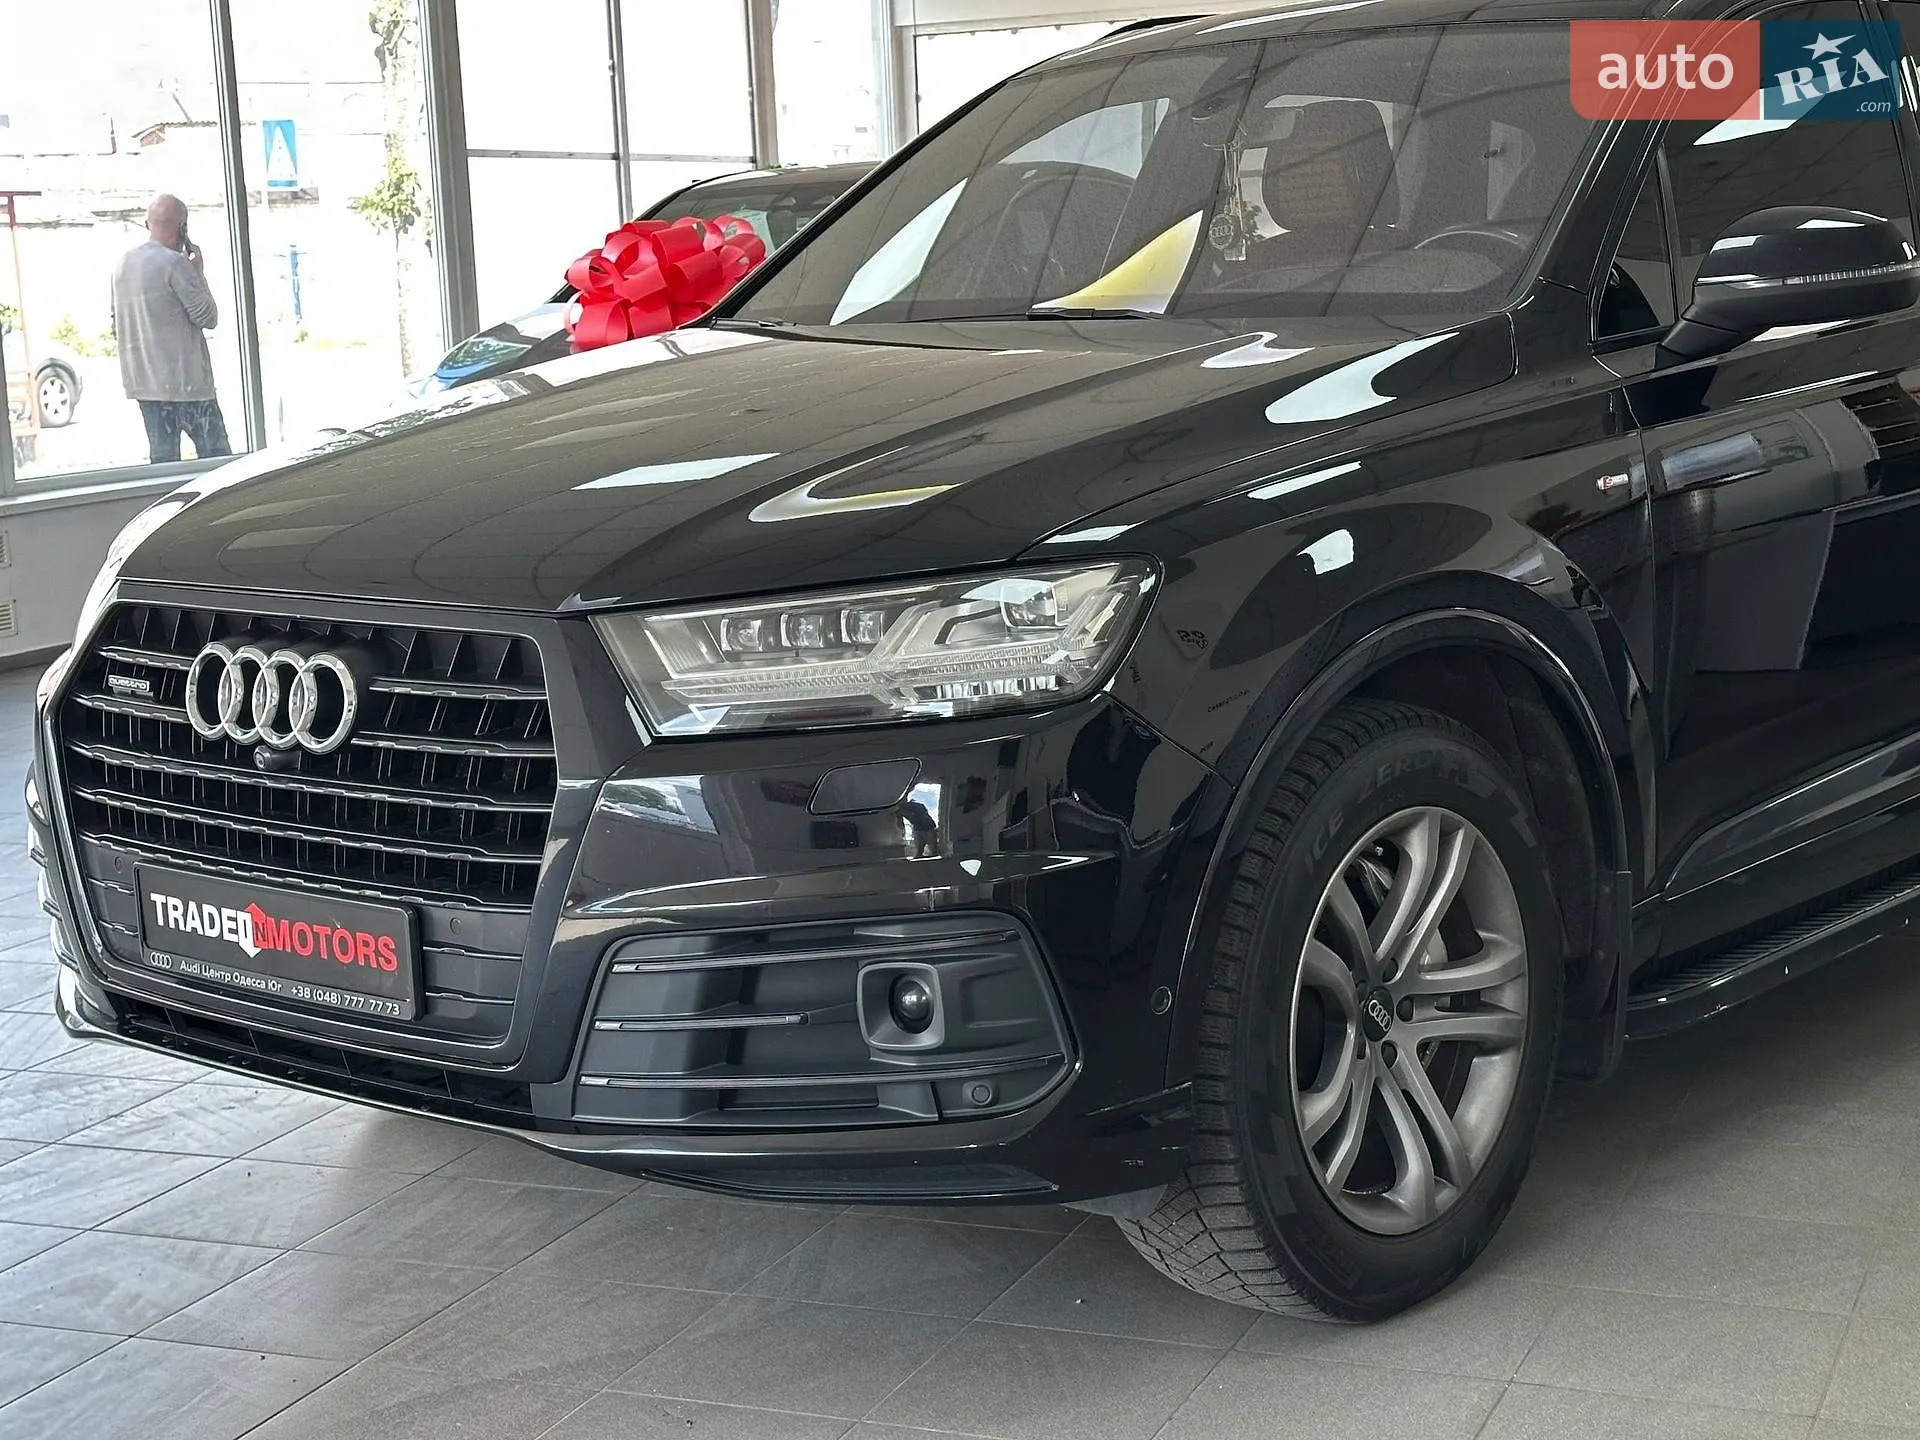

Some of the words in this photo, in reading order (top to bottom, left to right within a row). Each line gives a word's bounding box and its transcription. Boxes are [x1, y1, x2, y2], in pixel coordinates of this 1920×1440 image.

[109, 676, 147, 690] quattro
[150, 892, 239, 943] TRADE
[267, 916, 398, 972] MOTORS
[180, 960, 200, 974] Audi
[202, 964, 231, 983] Центр
[233, 972, 266, 989] Одесса
[268, 980, 282, 992] Юг
[291, 986, 311, 999] +38
[313, 988, 341, 1005] (048)
[344, 995, 365, 1009] 777
[369, 999, 383, 1012] 77
[386, 1002, 400, 1016] 73
